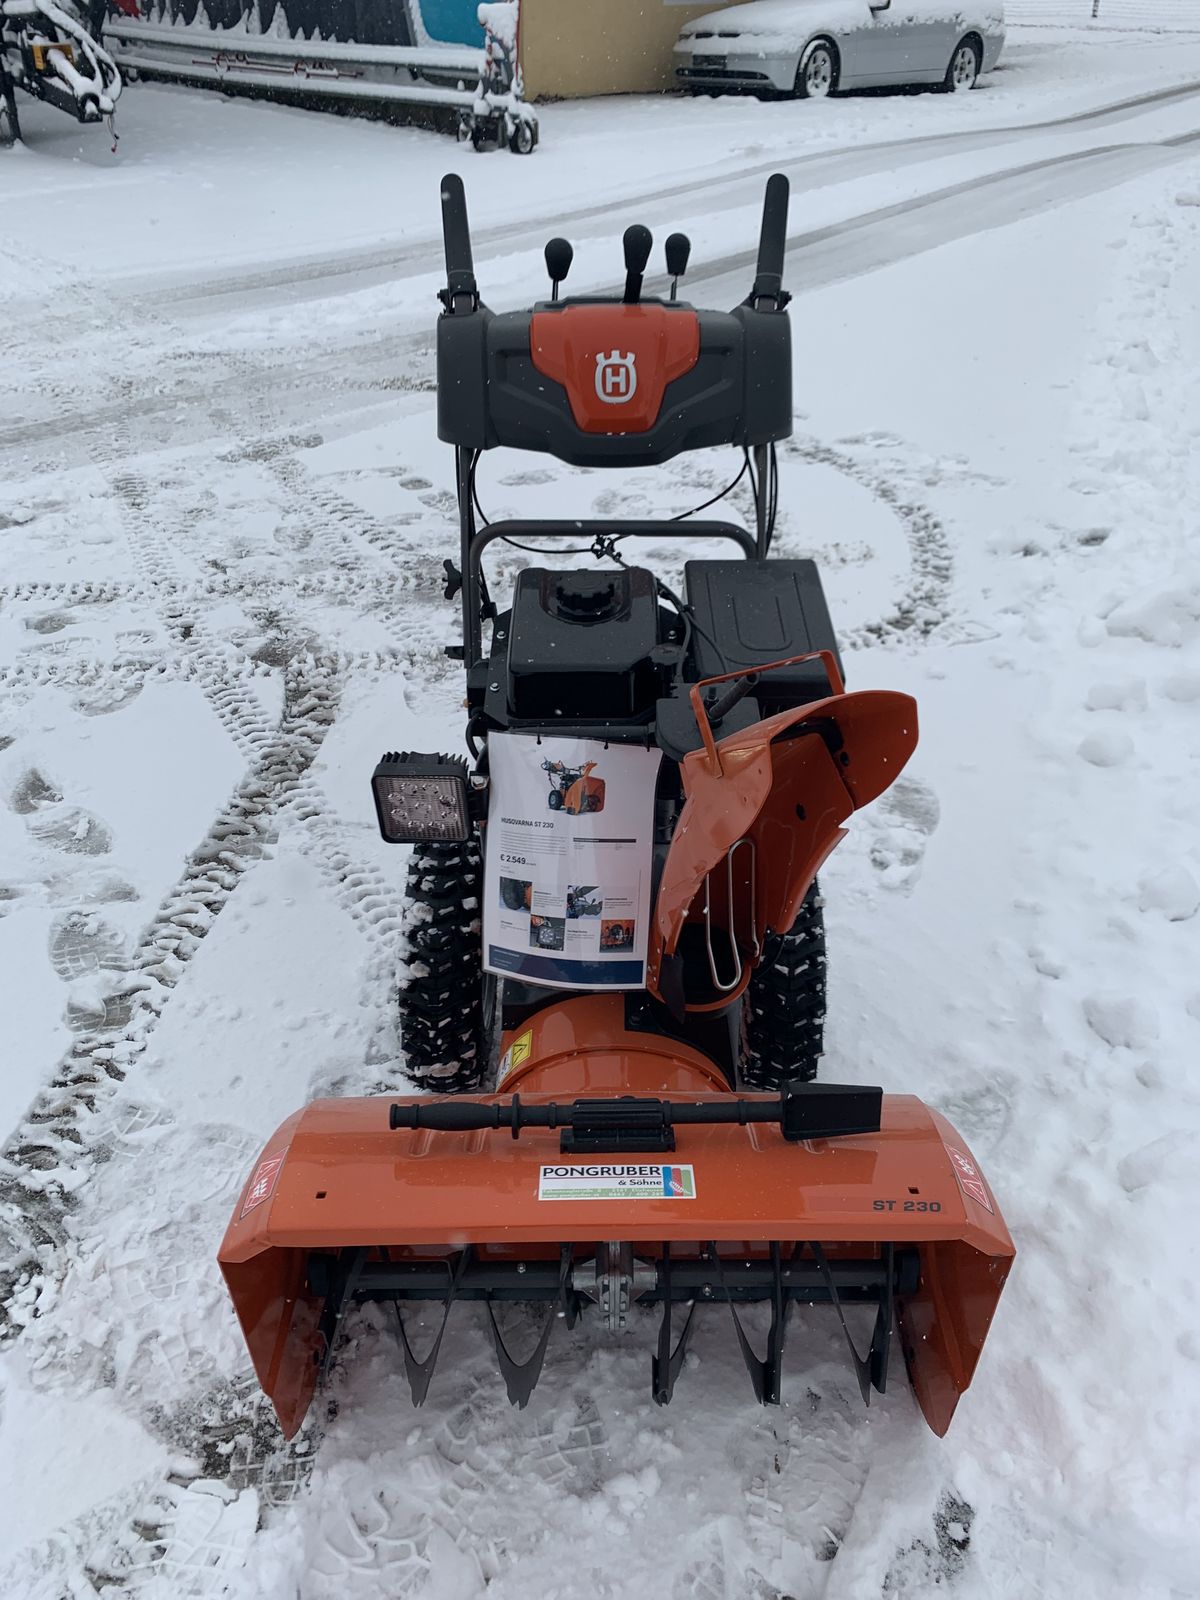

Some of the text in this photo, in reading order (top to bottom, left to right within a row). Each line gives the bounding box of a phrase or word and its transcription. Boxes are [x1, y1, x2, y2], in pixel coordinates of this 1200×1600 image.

[605, 367, 626, 393] H
[501, 817, 533, 827] HUSQVARNA
[542, 821, 554, 829] 230
[543, 1166, 662, 1177] PONGRUBER
[873, 1200, 942, 1212] ST 230
